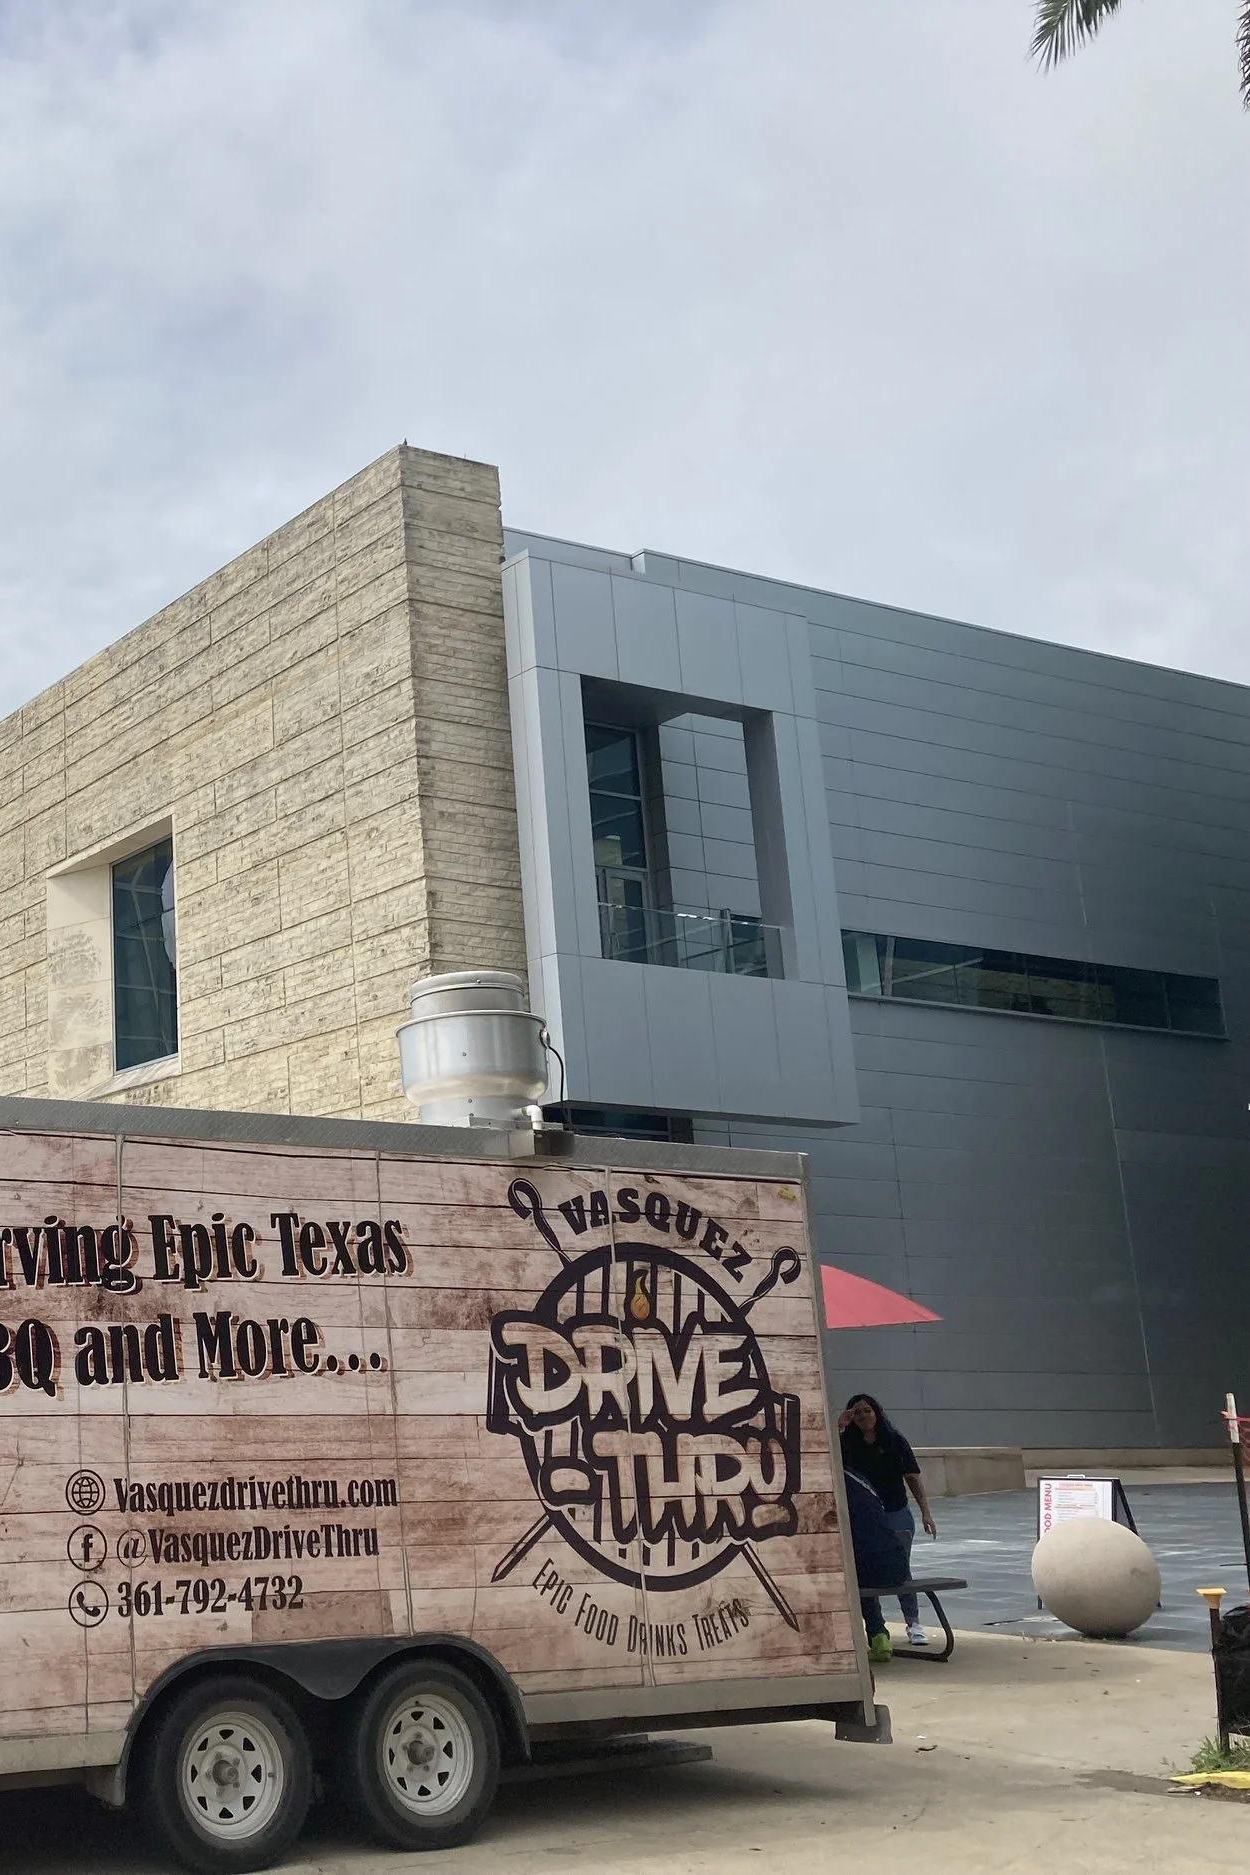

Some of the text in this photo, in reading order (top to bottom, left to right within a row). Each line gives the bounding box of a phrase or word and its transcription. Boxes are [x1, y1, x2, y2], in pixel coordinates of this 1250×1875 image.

[148, 1212, 261, 1291] Epic
[271, 1212, 411, 1280] Texas
[557, 1187, 752, 1284] VASQUEZ
[74, 1313, 181, 1387] and
[193, 1310, 385, 1381] More...
[501, 1321, 760, 1424] DRIVE
[113, 1475, 399, 1517] Vasquezdrivethru.com
[592, 1429, 787, 1531] THRU
[1044, 1483, 1052, 1511] MENU
[116, 1523, 380, 1568] @VasquezDriveThru
[117, 1575, 304, 1618] 361-792-4732
[532, 1557, 750, 1657] EPIC FOOD DRINKS TREATS
